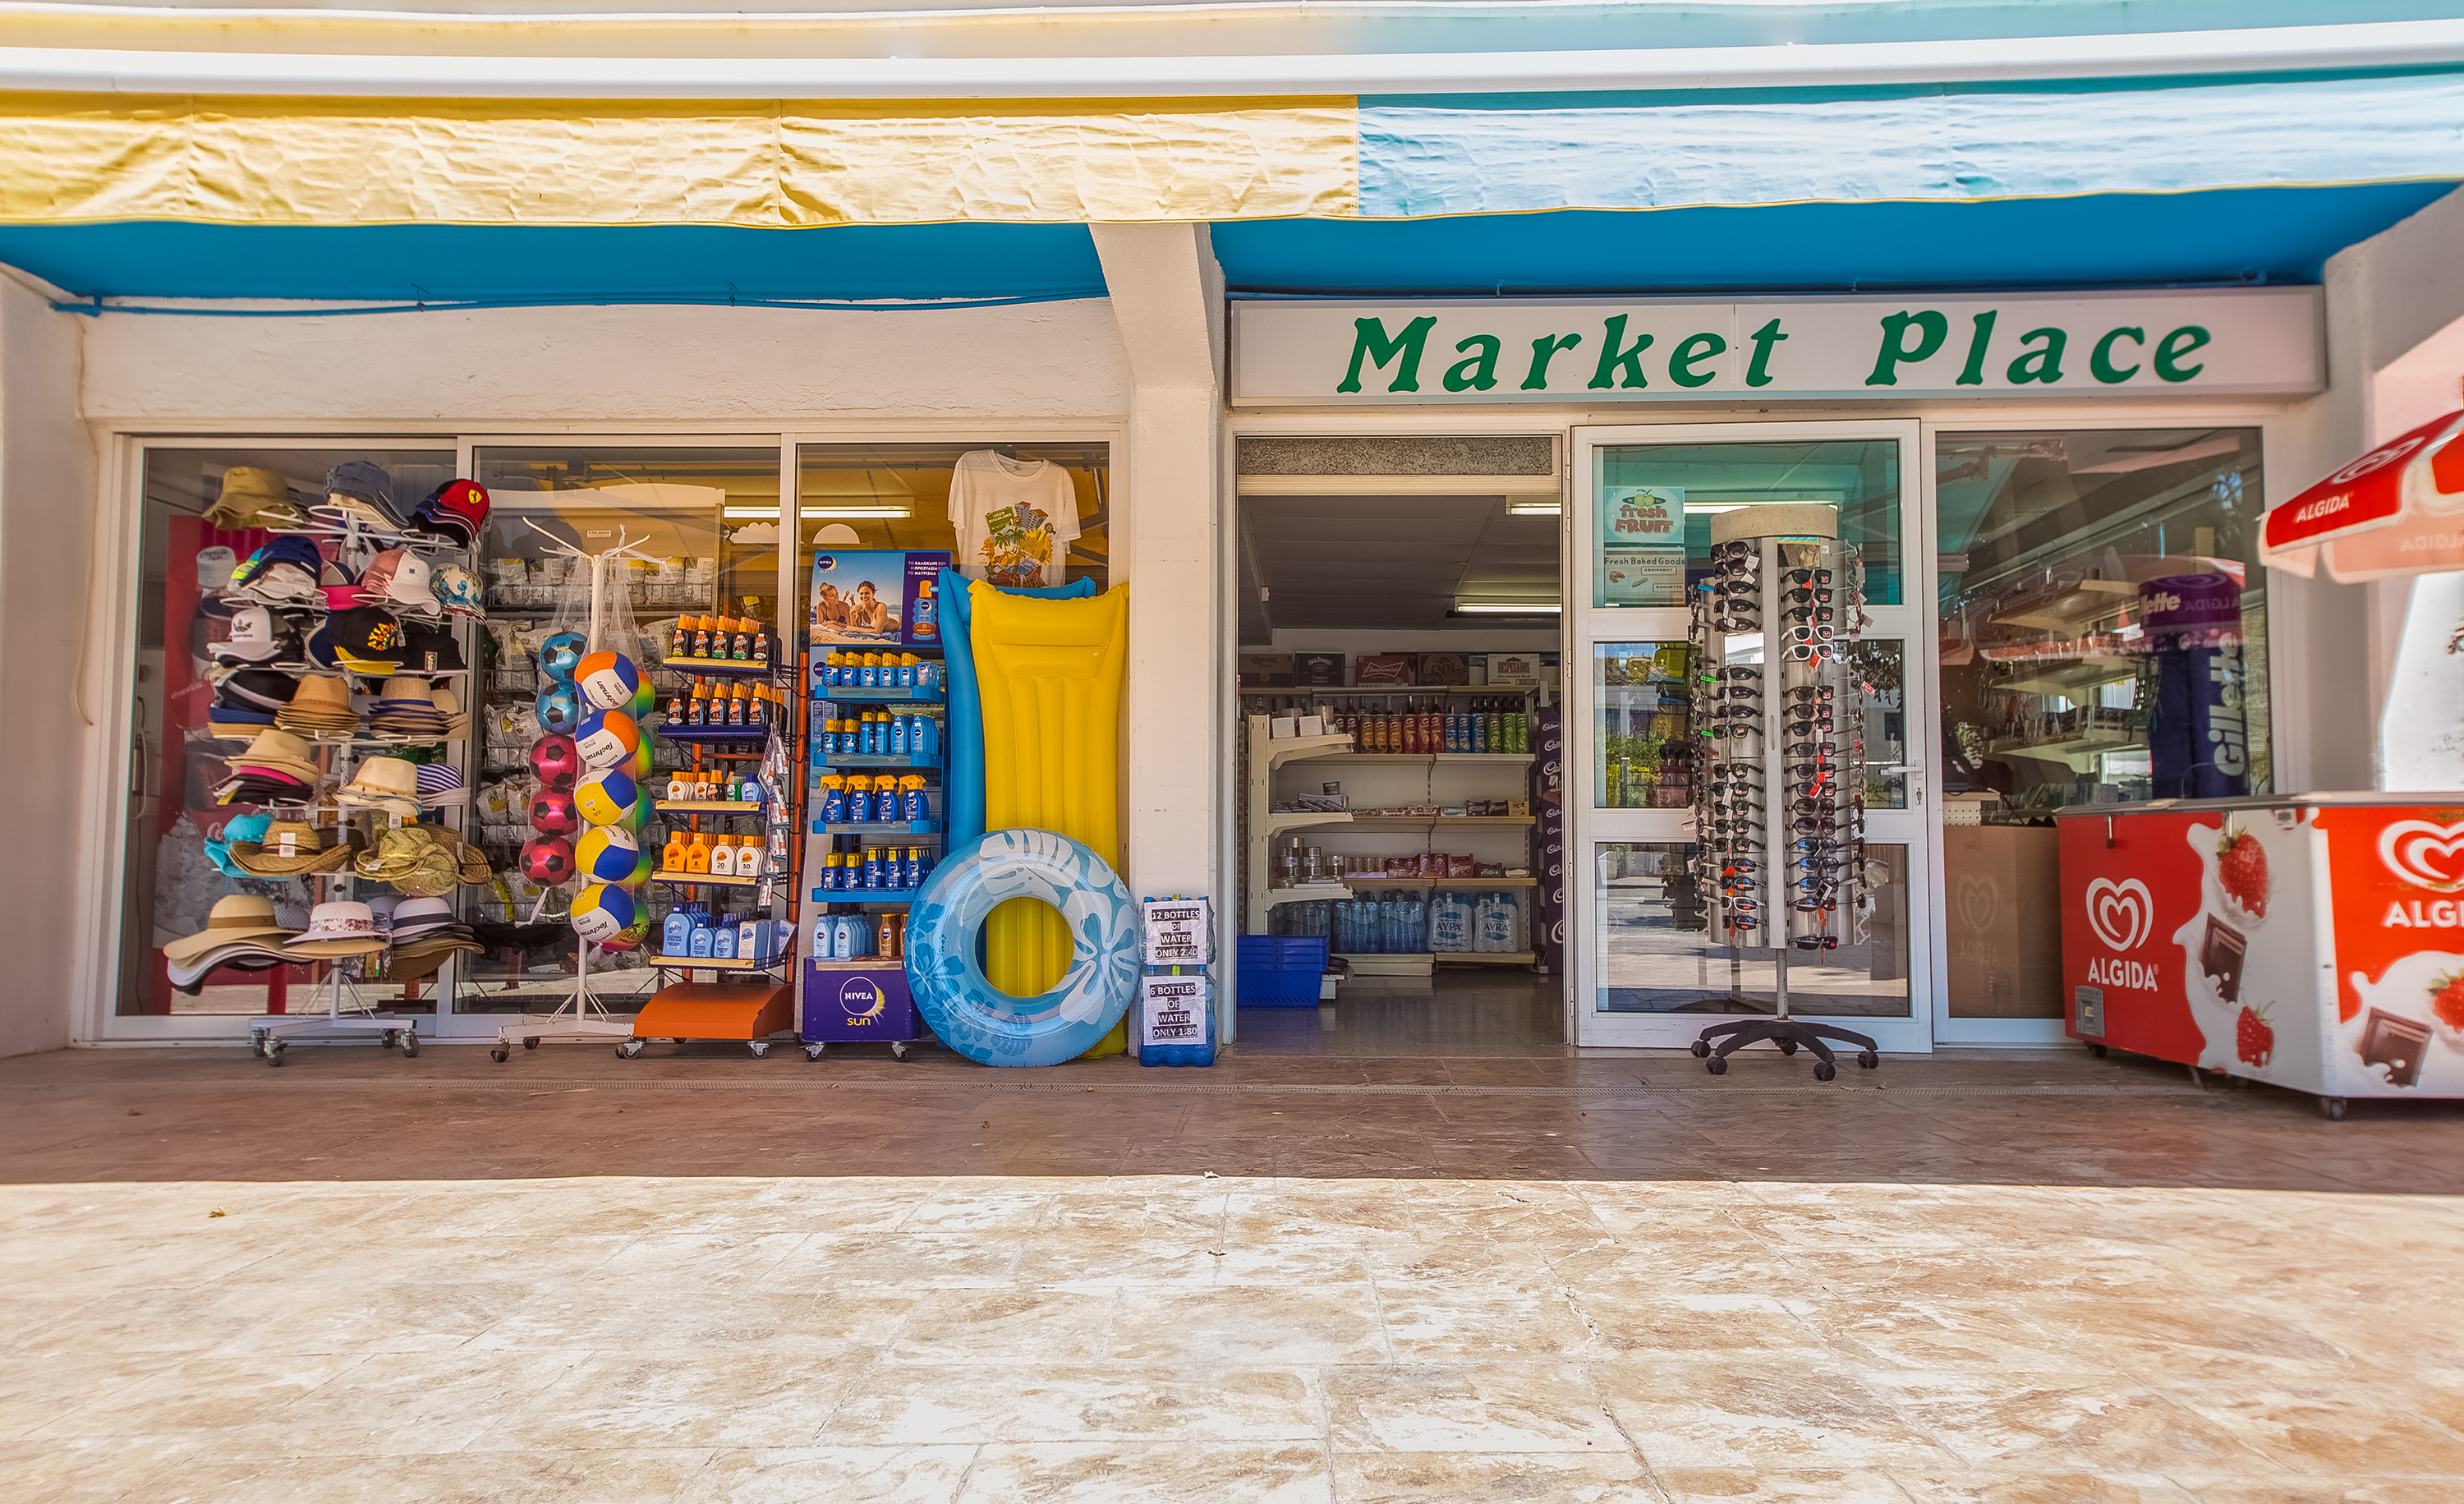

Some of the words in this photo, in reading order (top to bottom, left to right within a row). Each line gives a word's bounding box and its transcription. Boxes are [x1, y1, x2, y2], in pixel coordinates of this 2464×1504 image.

[1336, 314, 1789, 394] Market
[1864, 308, 2212, 388] Place
[1620, 504, 1667, 518] fresh
[2293, 493, 2350, 523] ALGIDA
[1615, 518, 1673, 533] FRUIT
[1365, 665, 1402, 674] Budweiser
[1497, 661, 1530, 674] DESPERADOS
[2208, 631, 2246, 777] Gillette
[1152, 911, 1162, 920] 12
[1164, 909, 1200, 919] BOTTLES
[1161, 934, 1192, 944] WATER
[1385, 933, 1412, 941] KYKKOS
[1156, 948, 1178, 958] ONLY
[2087, 956, 2159, 993] ALGIDA
[1150, 987, 1156, 996] 6
[1159, 985, 1196, 995] BOTTLES
[1167, 1000, 1179, 1008] OF
[847, 1018, 871, 1026] sun
[1158, 1014, 1190, 1023] WATER
[1152, 1028, 1175, 1037] ONLY
[1179, 1027, 1198, 1036] 1.80
